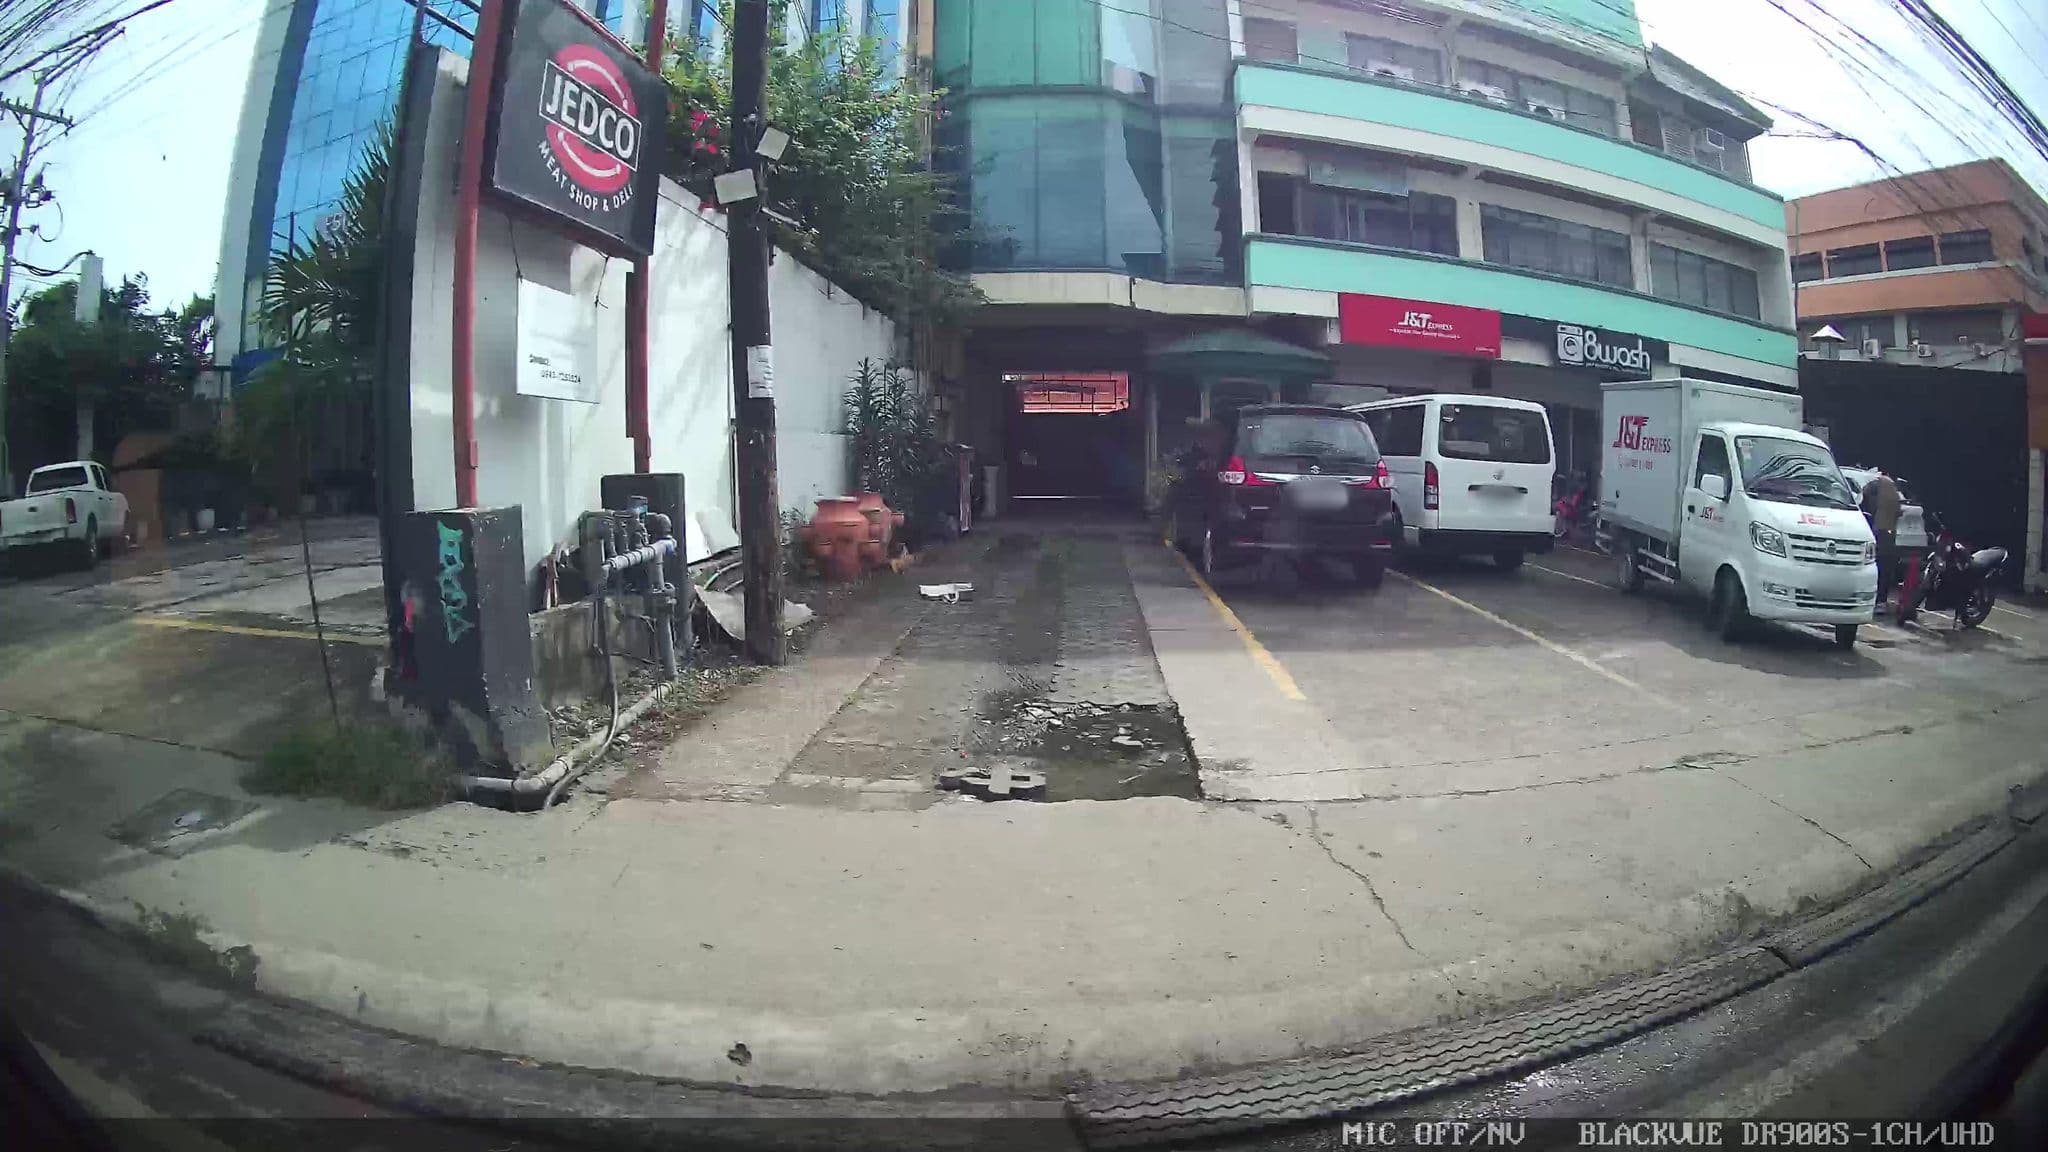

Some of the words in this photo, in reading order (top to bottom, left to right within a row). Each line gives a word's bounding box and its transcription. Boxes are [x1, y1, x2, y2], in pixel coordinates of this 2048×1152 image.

[546, 73, 635, 159] JEDCO
[538, 140, 568, 189] MEAT
[568, 184, 599, 211] SHOP
[603, 199, 609, 211] &
[613, 185, 634, 209] DELI
[1398, 311, 1432, 329] J&T
[1612, 415, 1649, 450] J&T
